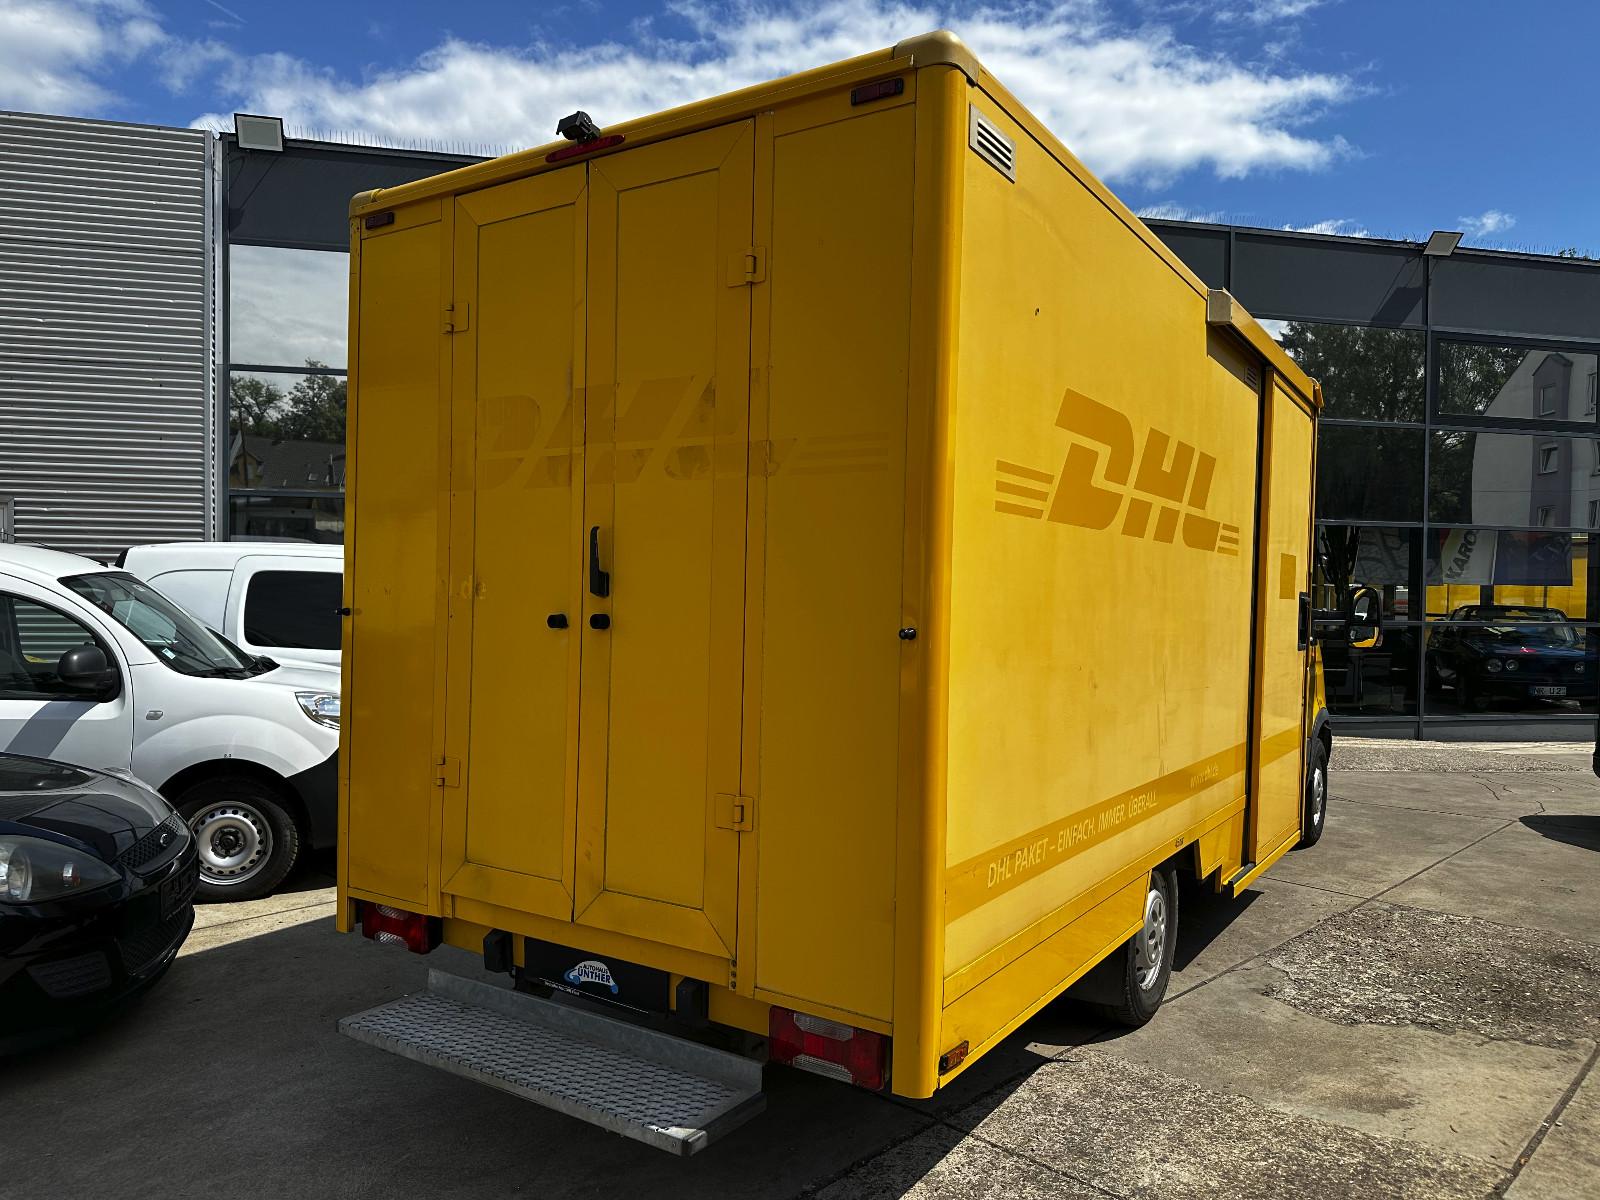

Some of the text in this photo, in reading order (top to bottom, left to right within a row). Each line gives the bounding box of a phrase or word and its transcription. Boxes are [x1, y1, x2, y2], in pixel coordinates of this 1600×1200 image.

[1047, 388, 1220, 552] DHL
[1445, 530, 1481, 579] KARO
[987, 855, 1012, 888] DHL
[1014, 838, 1049, 874] PAKET
